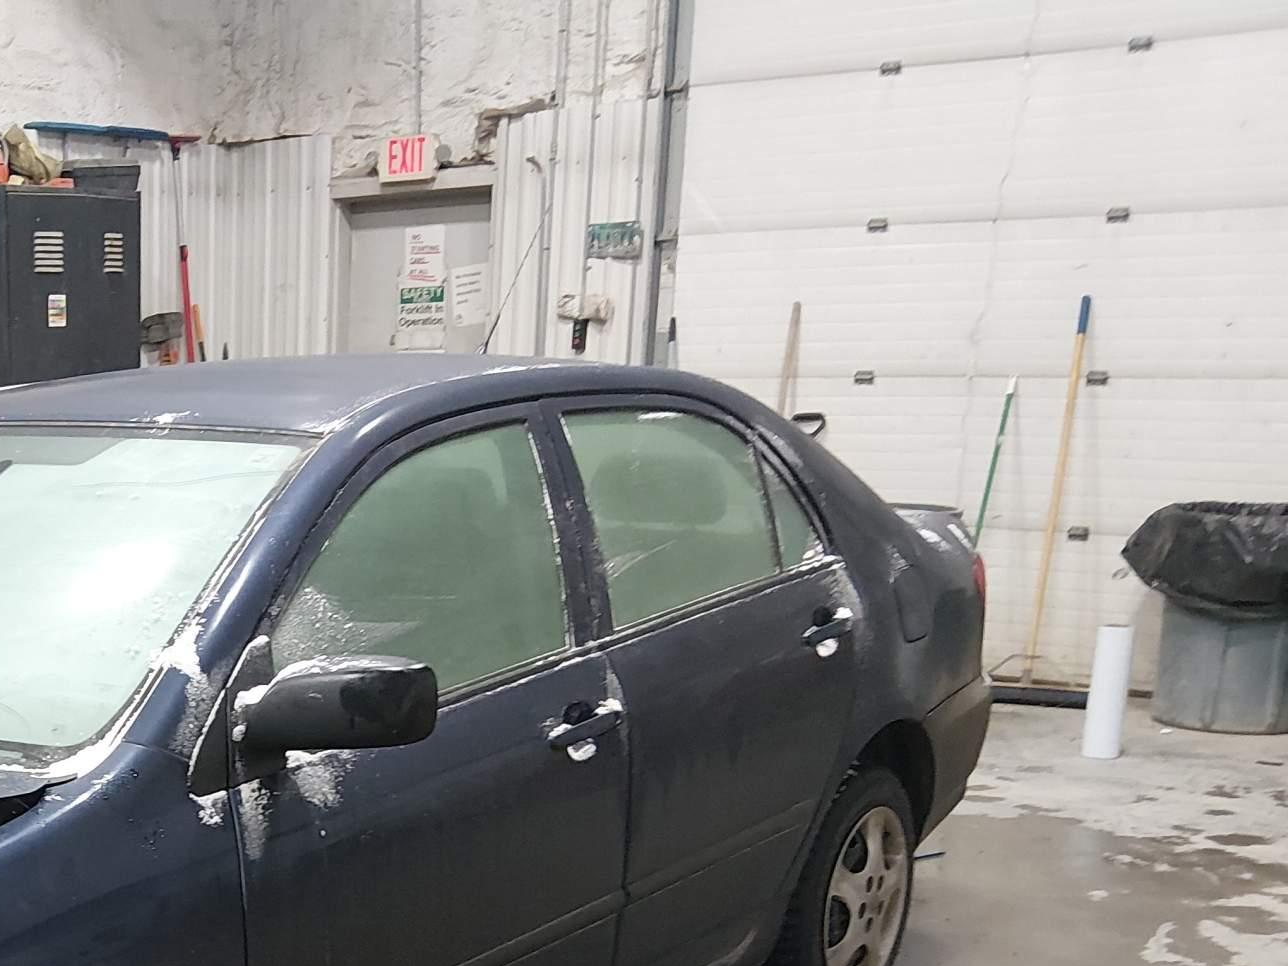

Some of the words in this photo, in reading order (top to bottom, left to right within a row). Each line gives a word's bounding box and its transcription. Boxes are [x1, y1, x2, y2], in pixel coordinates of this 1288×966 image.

[388, 137, 425, 175] EXIT
[401, 287, 444, 299] SAFETY
[400, 304, 433, 315] Forklift
[399, 316, 444, 328] Operation
